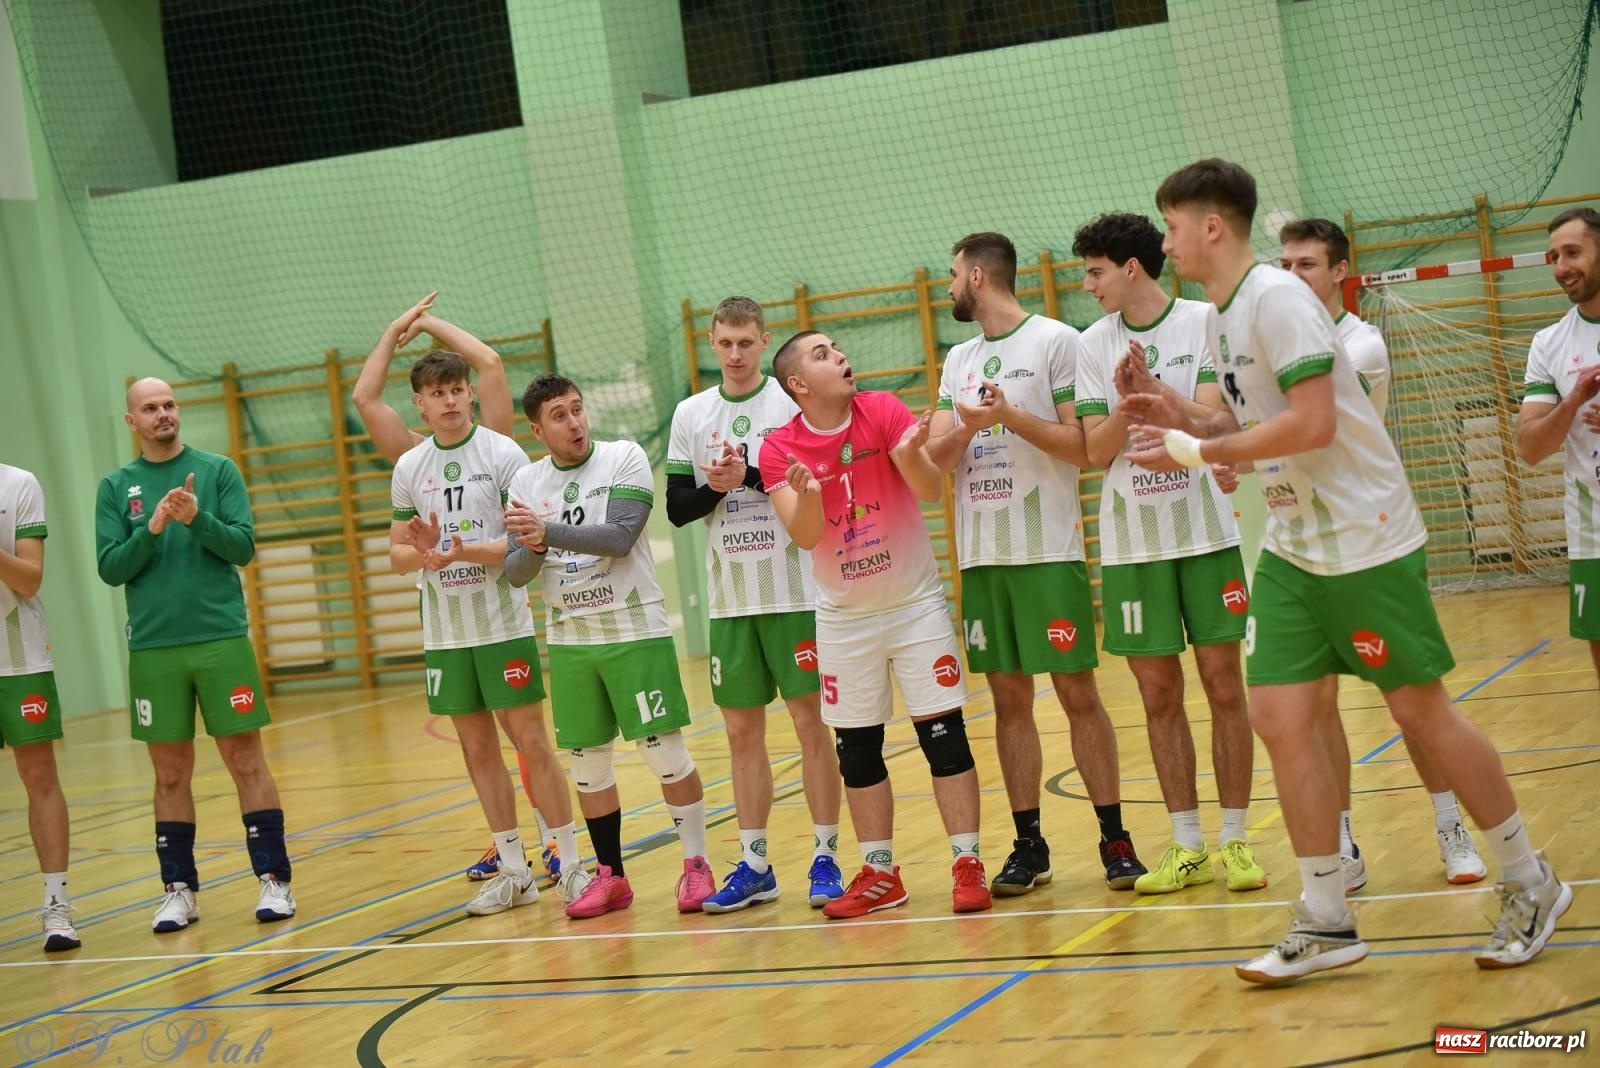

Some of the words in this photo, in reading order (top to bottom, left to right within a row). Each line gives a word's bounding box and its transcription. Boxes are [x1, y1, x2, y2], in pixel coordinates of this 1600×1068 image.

[970, 478, 1013, 494] PIVEXIN
[1132, 469, 1190, 488] PIVEXIN
[1133, 481, 1190, 497] TECHNOLOGY
[444, 485, 464, 513] 17
[722, 530, 775, 547] PIVEXIN
[724, 543, 776, 554] TECHNOLOGY
[439, 565, 487, 582] PIVEXIN
[440, 576, 487, 588] TECHNOLOGY
[562, 584, 614, 604] PIVEXIN
[566, 596, 615, 610] TECHNOLOGY
[1575, 584, 1586, 617] 7
[1120, 600, 1143, 635] 11
[963, 619, 987, 651] 14
[426, 668, 443, 697] 17
[711, 656, 722, 686] 3
[820, 673, 839, 705] 15
[135, 698, 153, 726] 19
[635, 689, 667, 725] 12
